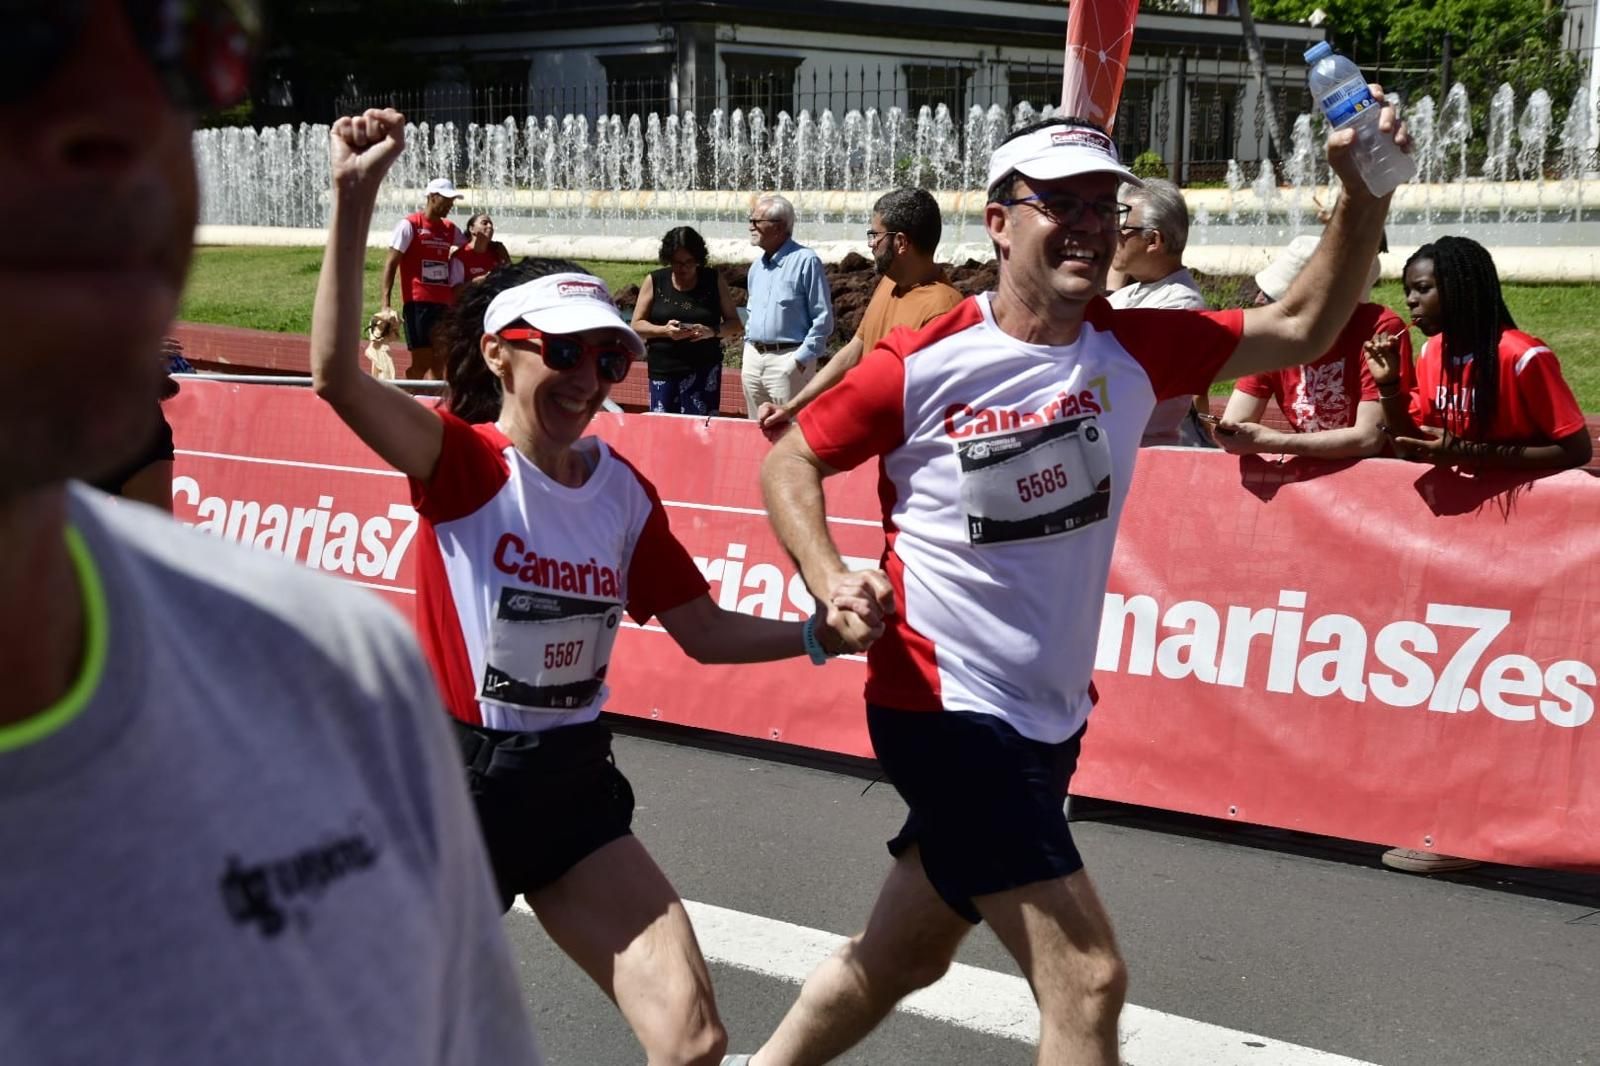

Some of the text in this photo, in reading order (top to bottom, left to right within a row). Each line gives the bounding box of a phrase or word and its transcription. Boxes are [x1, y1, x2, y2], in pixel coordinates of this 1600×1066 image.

[1016, 463, 1068, 503] 5585
[173, 475, 419, 580] Canarias7
[544, 640, 584, 669] 5587
